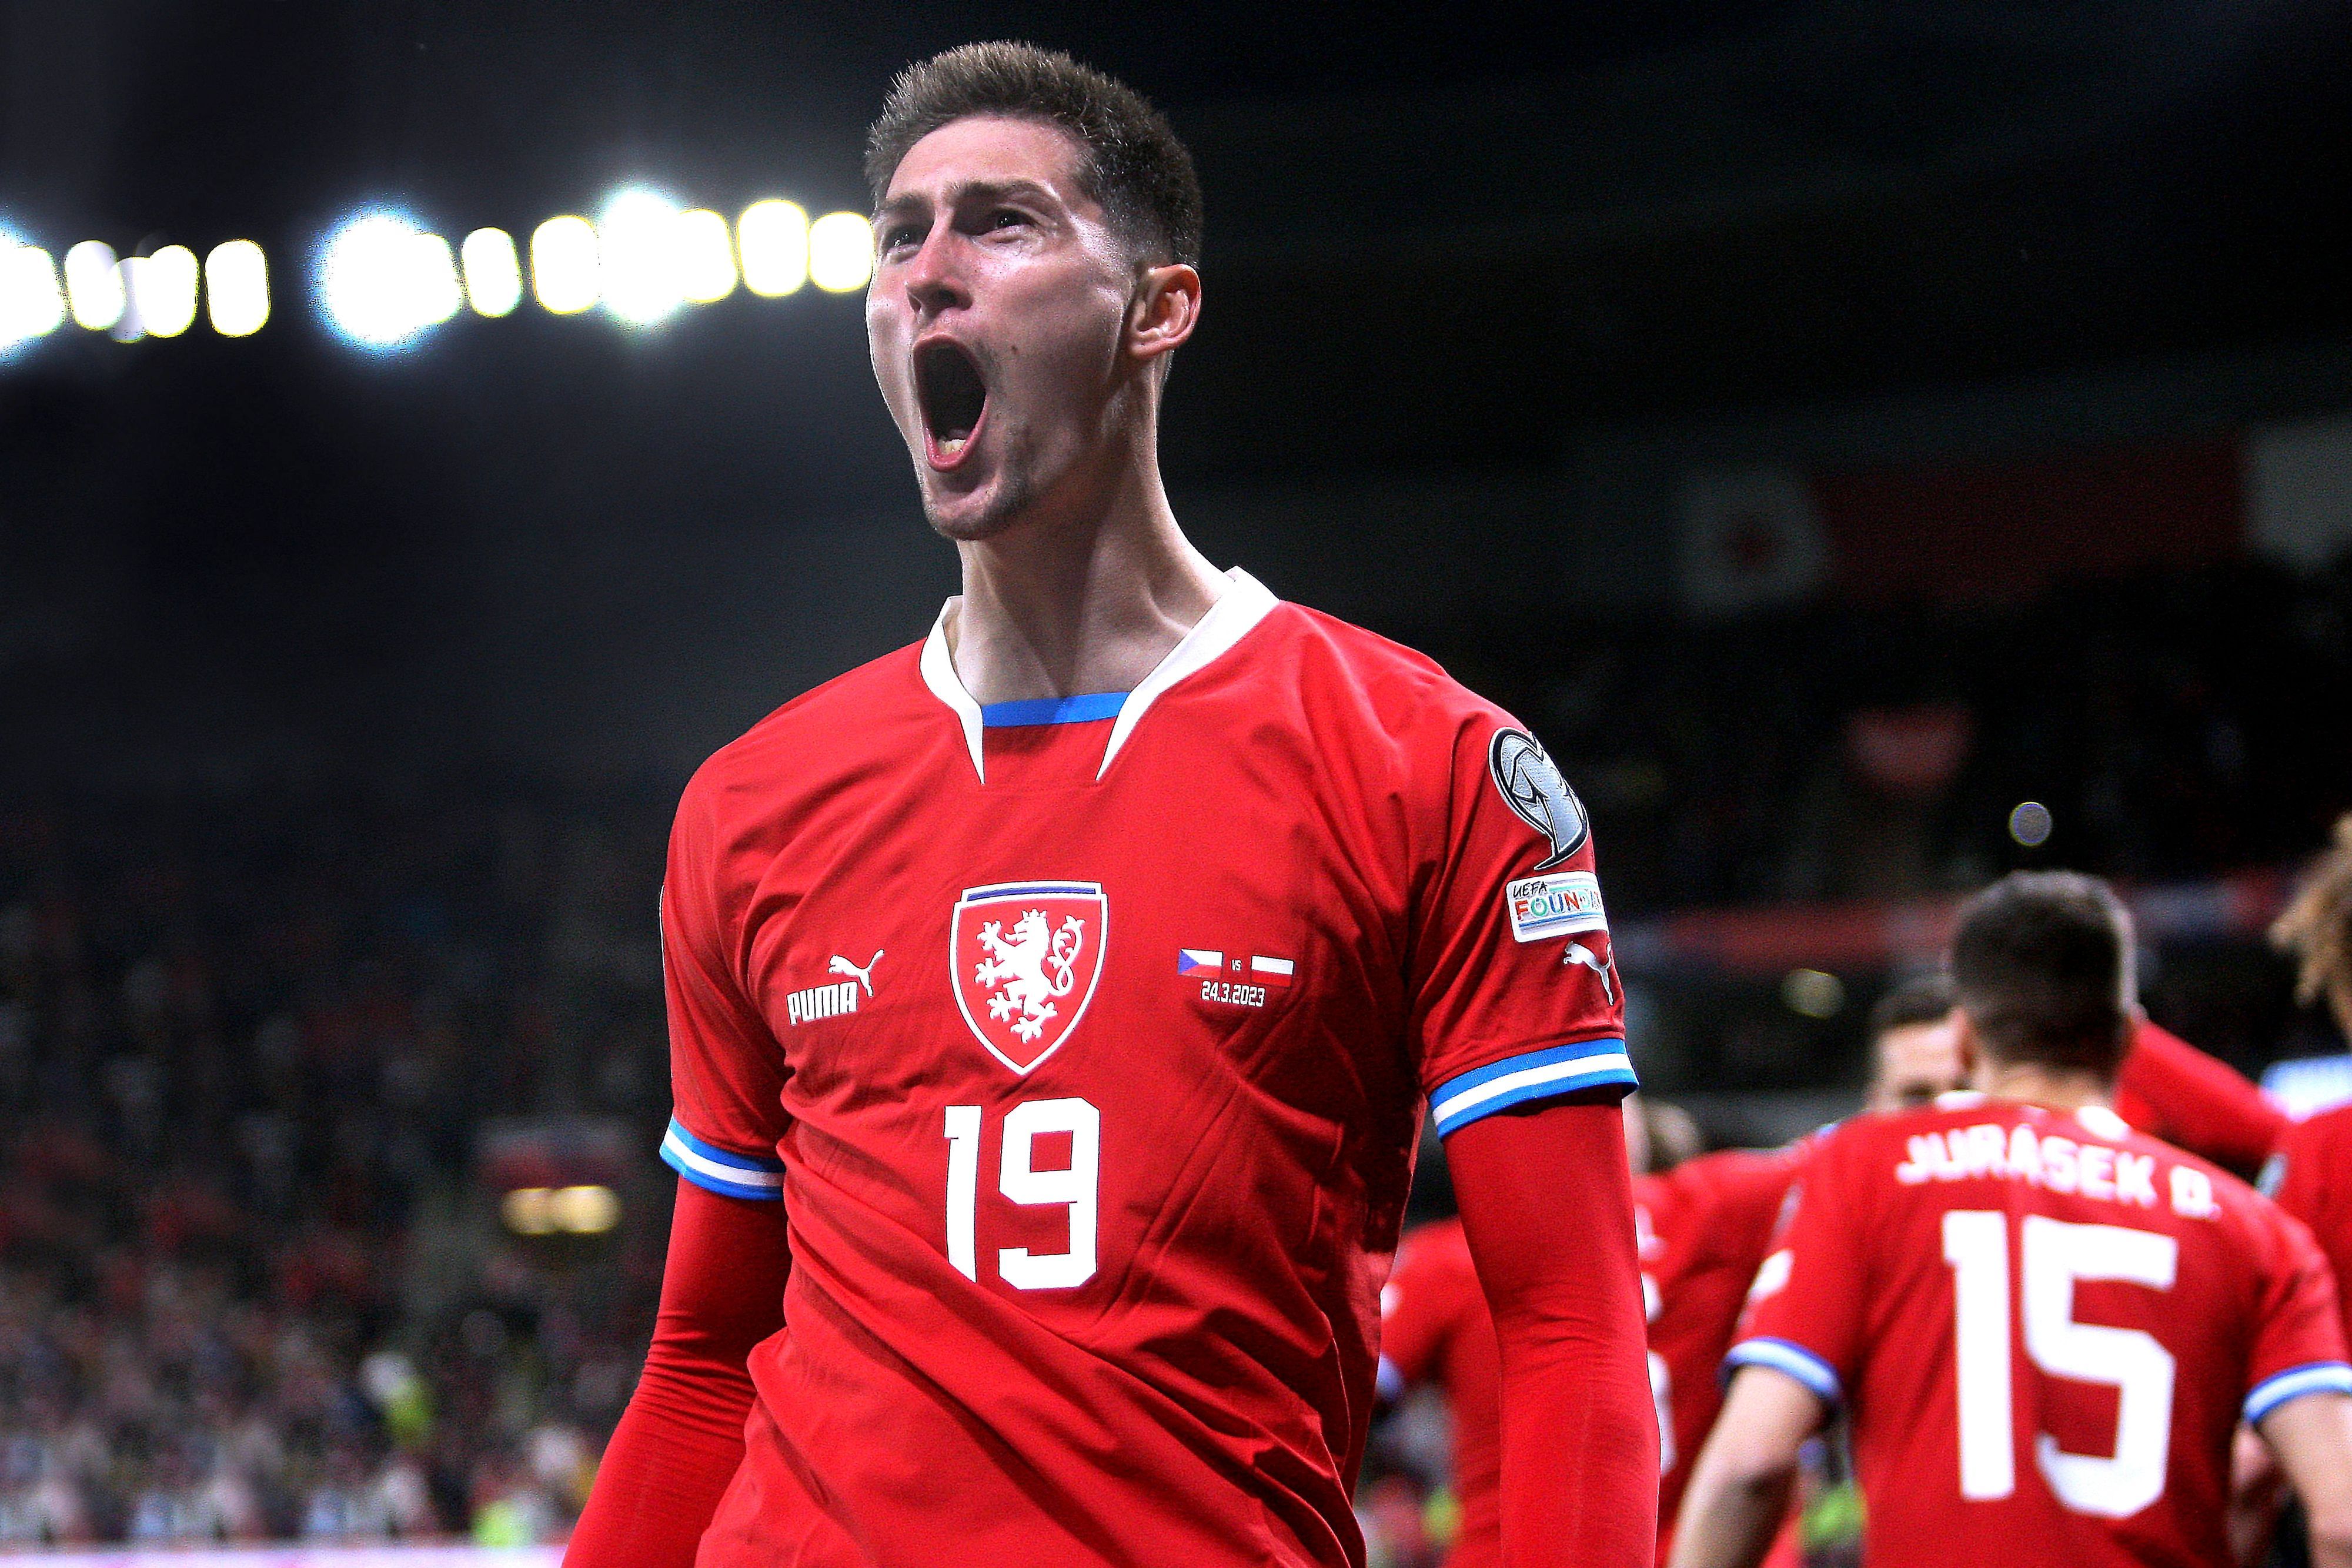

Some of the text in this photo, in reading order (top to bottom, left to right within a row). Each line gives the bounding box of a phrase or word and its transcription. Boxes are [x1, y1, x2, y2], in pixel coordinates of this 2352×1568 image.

[1513, 881, 1548, 898] UEFA
[786, 981, 858, 1026] PUMA
[1201, 981, 1265, 1007] 24.3.2023
[944, 1096, 1101, 1290] 19
[2170, 1165, 2222, 1220] D.
[1942, 1210, 2178, 1517] 15
